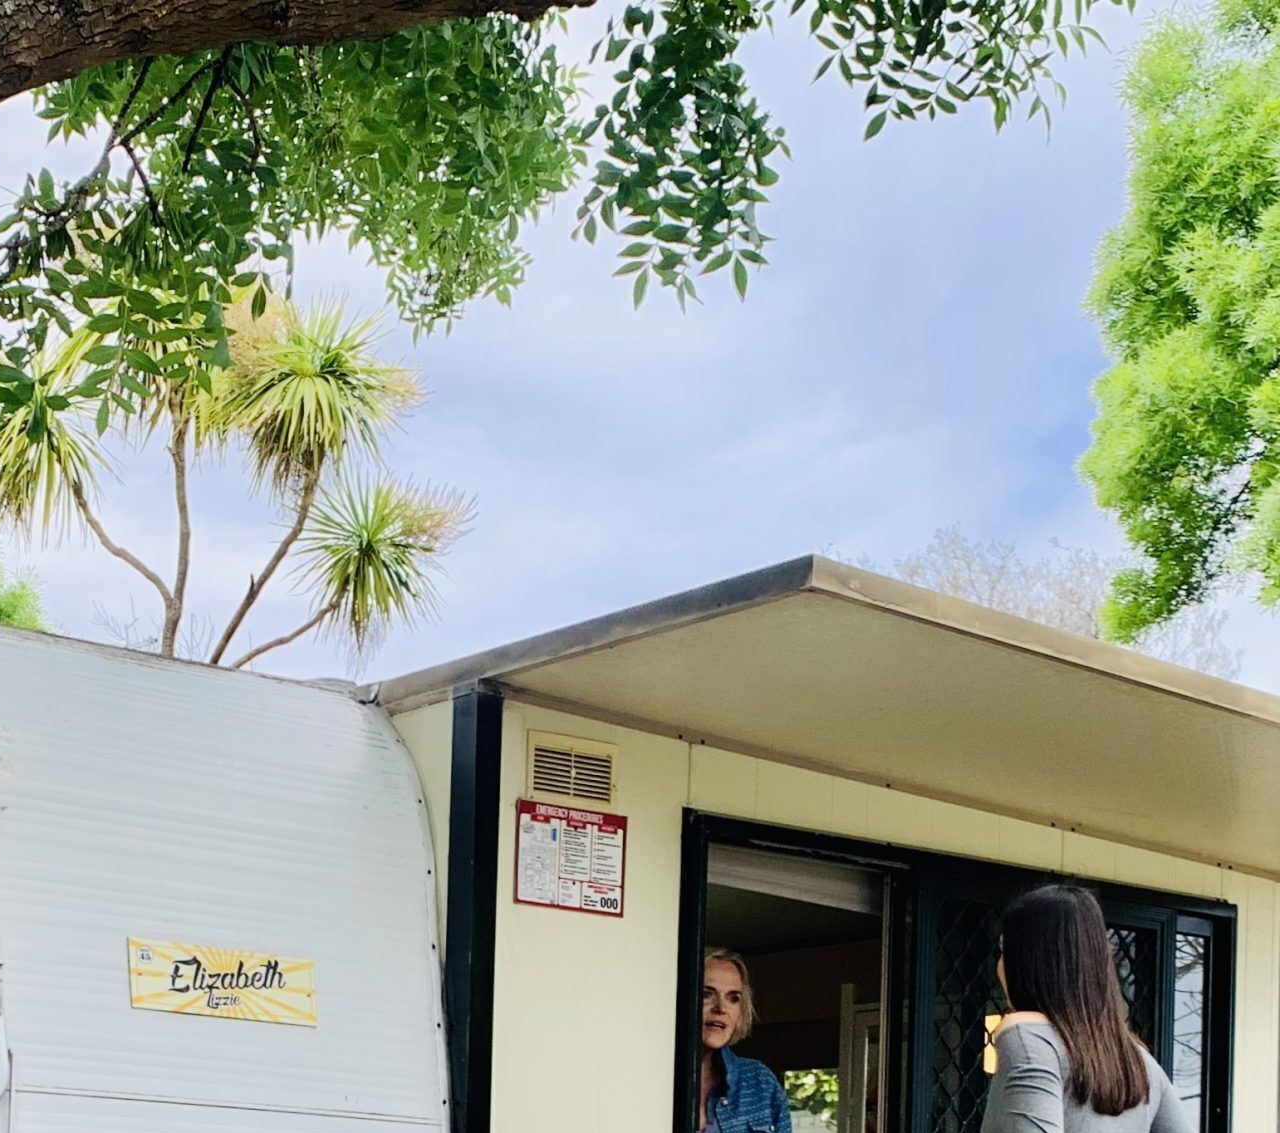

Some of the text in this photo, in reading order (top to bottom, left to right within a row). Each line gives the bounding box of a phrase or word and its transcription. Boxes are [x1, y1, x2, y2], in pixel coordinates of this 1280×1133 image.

[600, 897, 618, 910] 000
[168, 956, 286, 993] Elizabeth
[208, 991, 241, 1009] Lizzie
